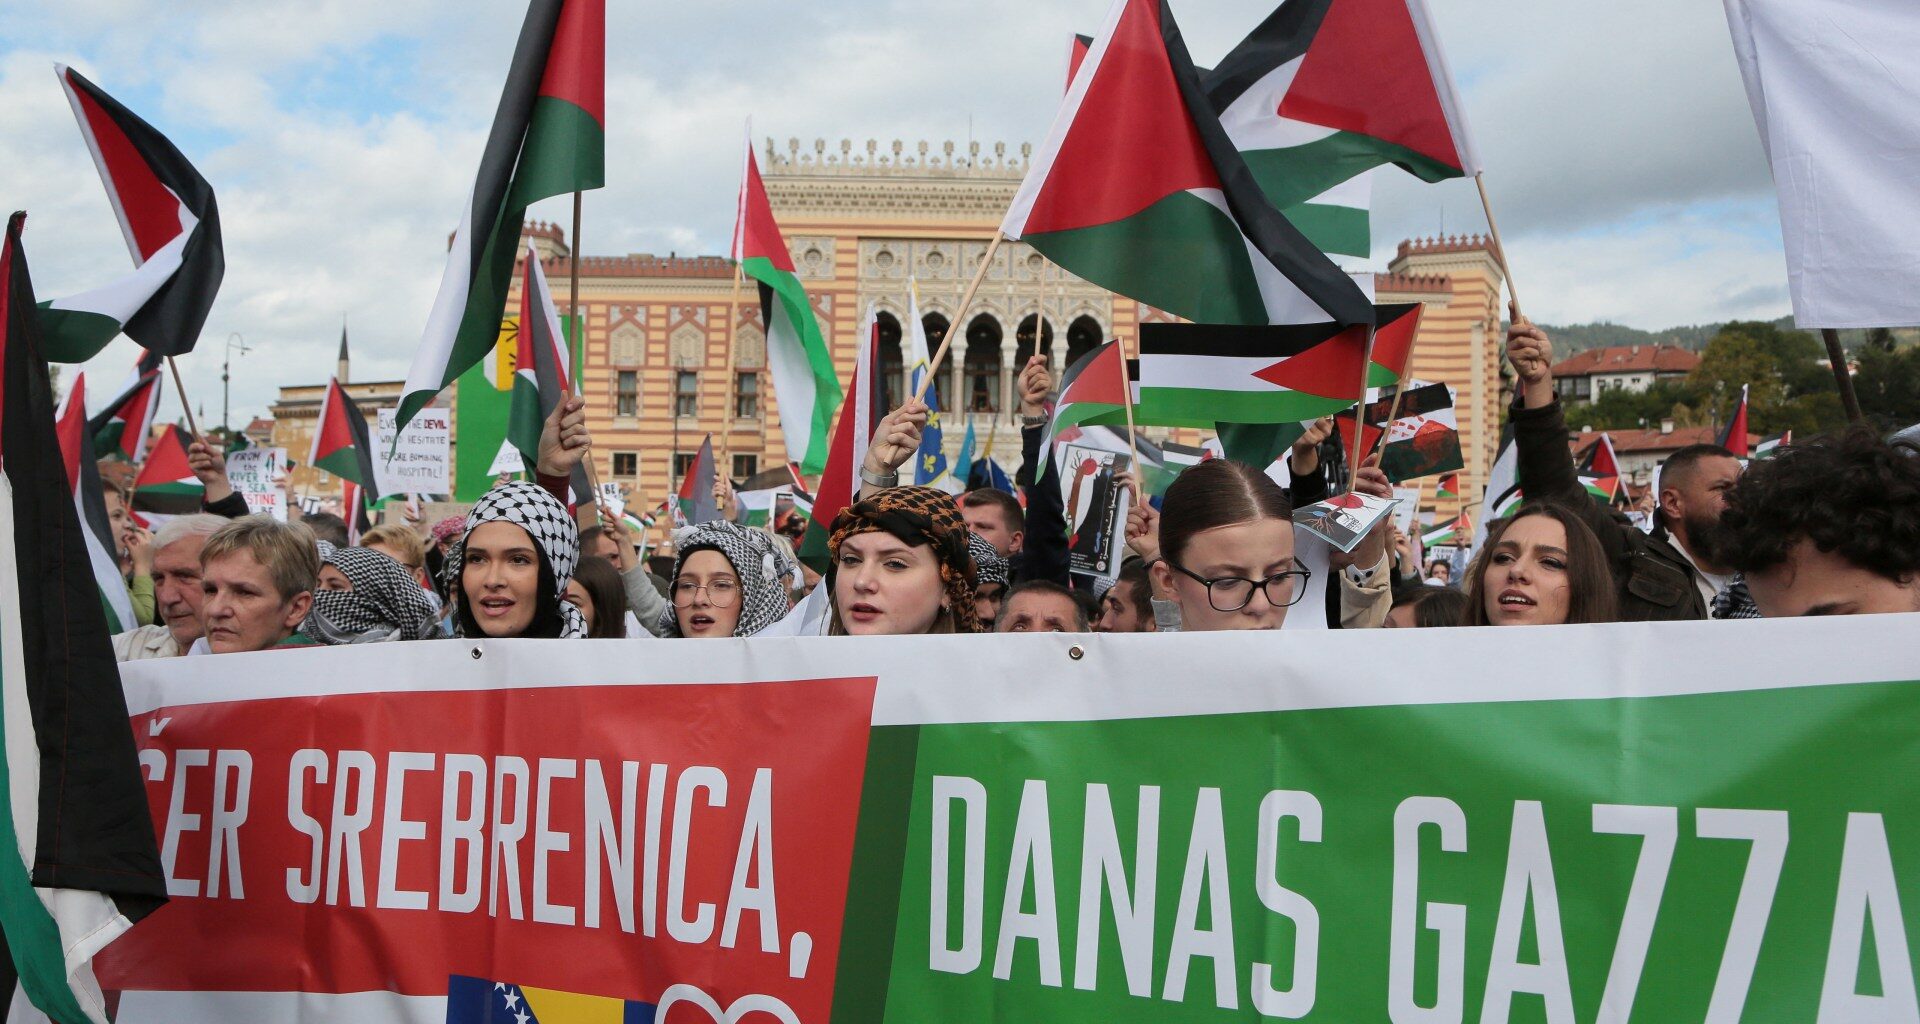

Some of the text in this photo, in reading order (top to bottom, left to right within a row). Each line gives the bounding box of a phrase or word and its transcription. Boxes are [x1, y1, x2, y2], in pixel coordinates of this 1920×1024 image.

[379, 412, 397, 430] EVE
[424, 419, 447, 429] DEVIL
[380, 435, 446, 445] WOUD HESITATE
[234, 452, 261, 461] FROM
[381, 451, 407, 461] BEORE
[229, 472, 258, 483] RIVER
[248, 483, 267, 492] SEA
[286, 748, 813, 979] SREBRENICA,
[929, 775, 1322, 1018] DANAS
